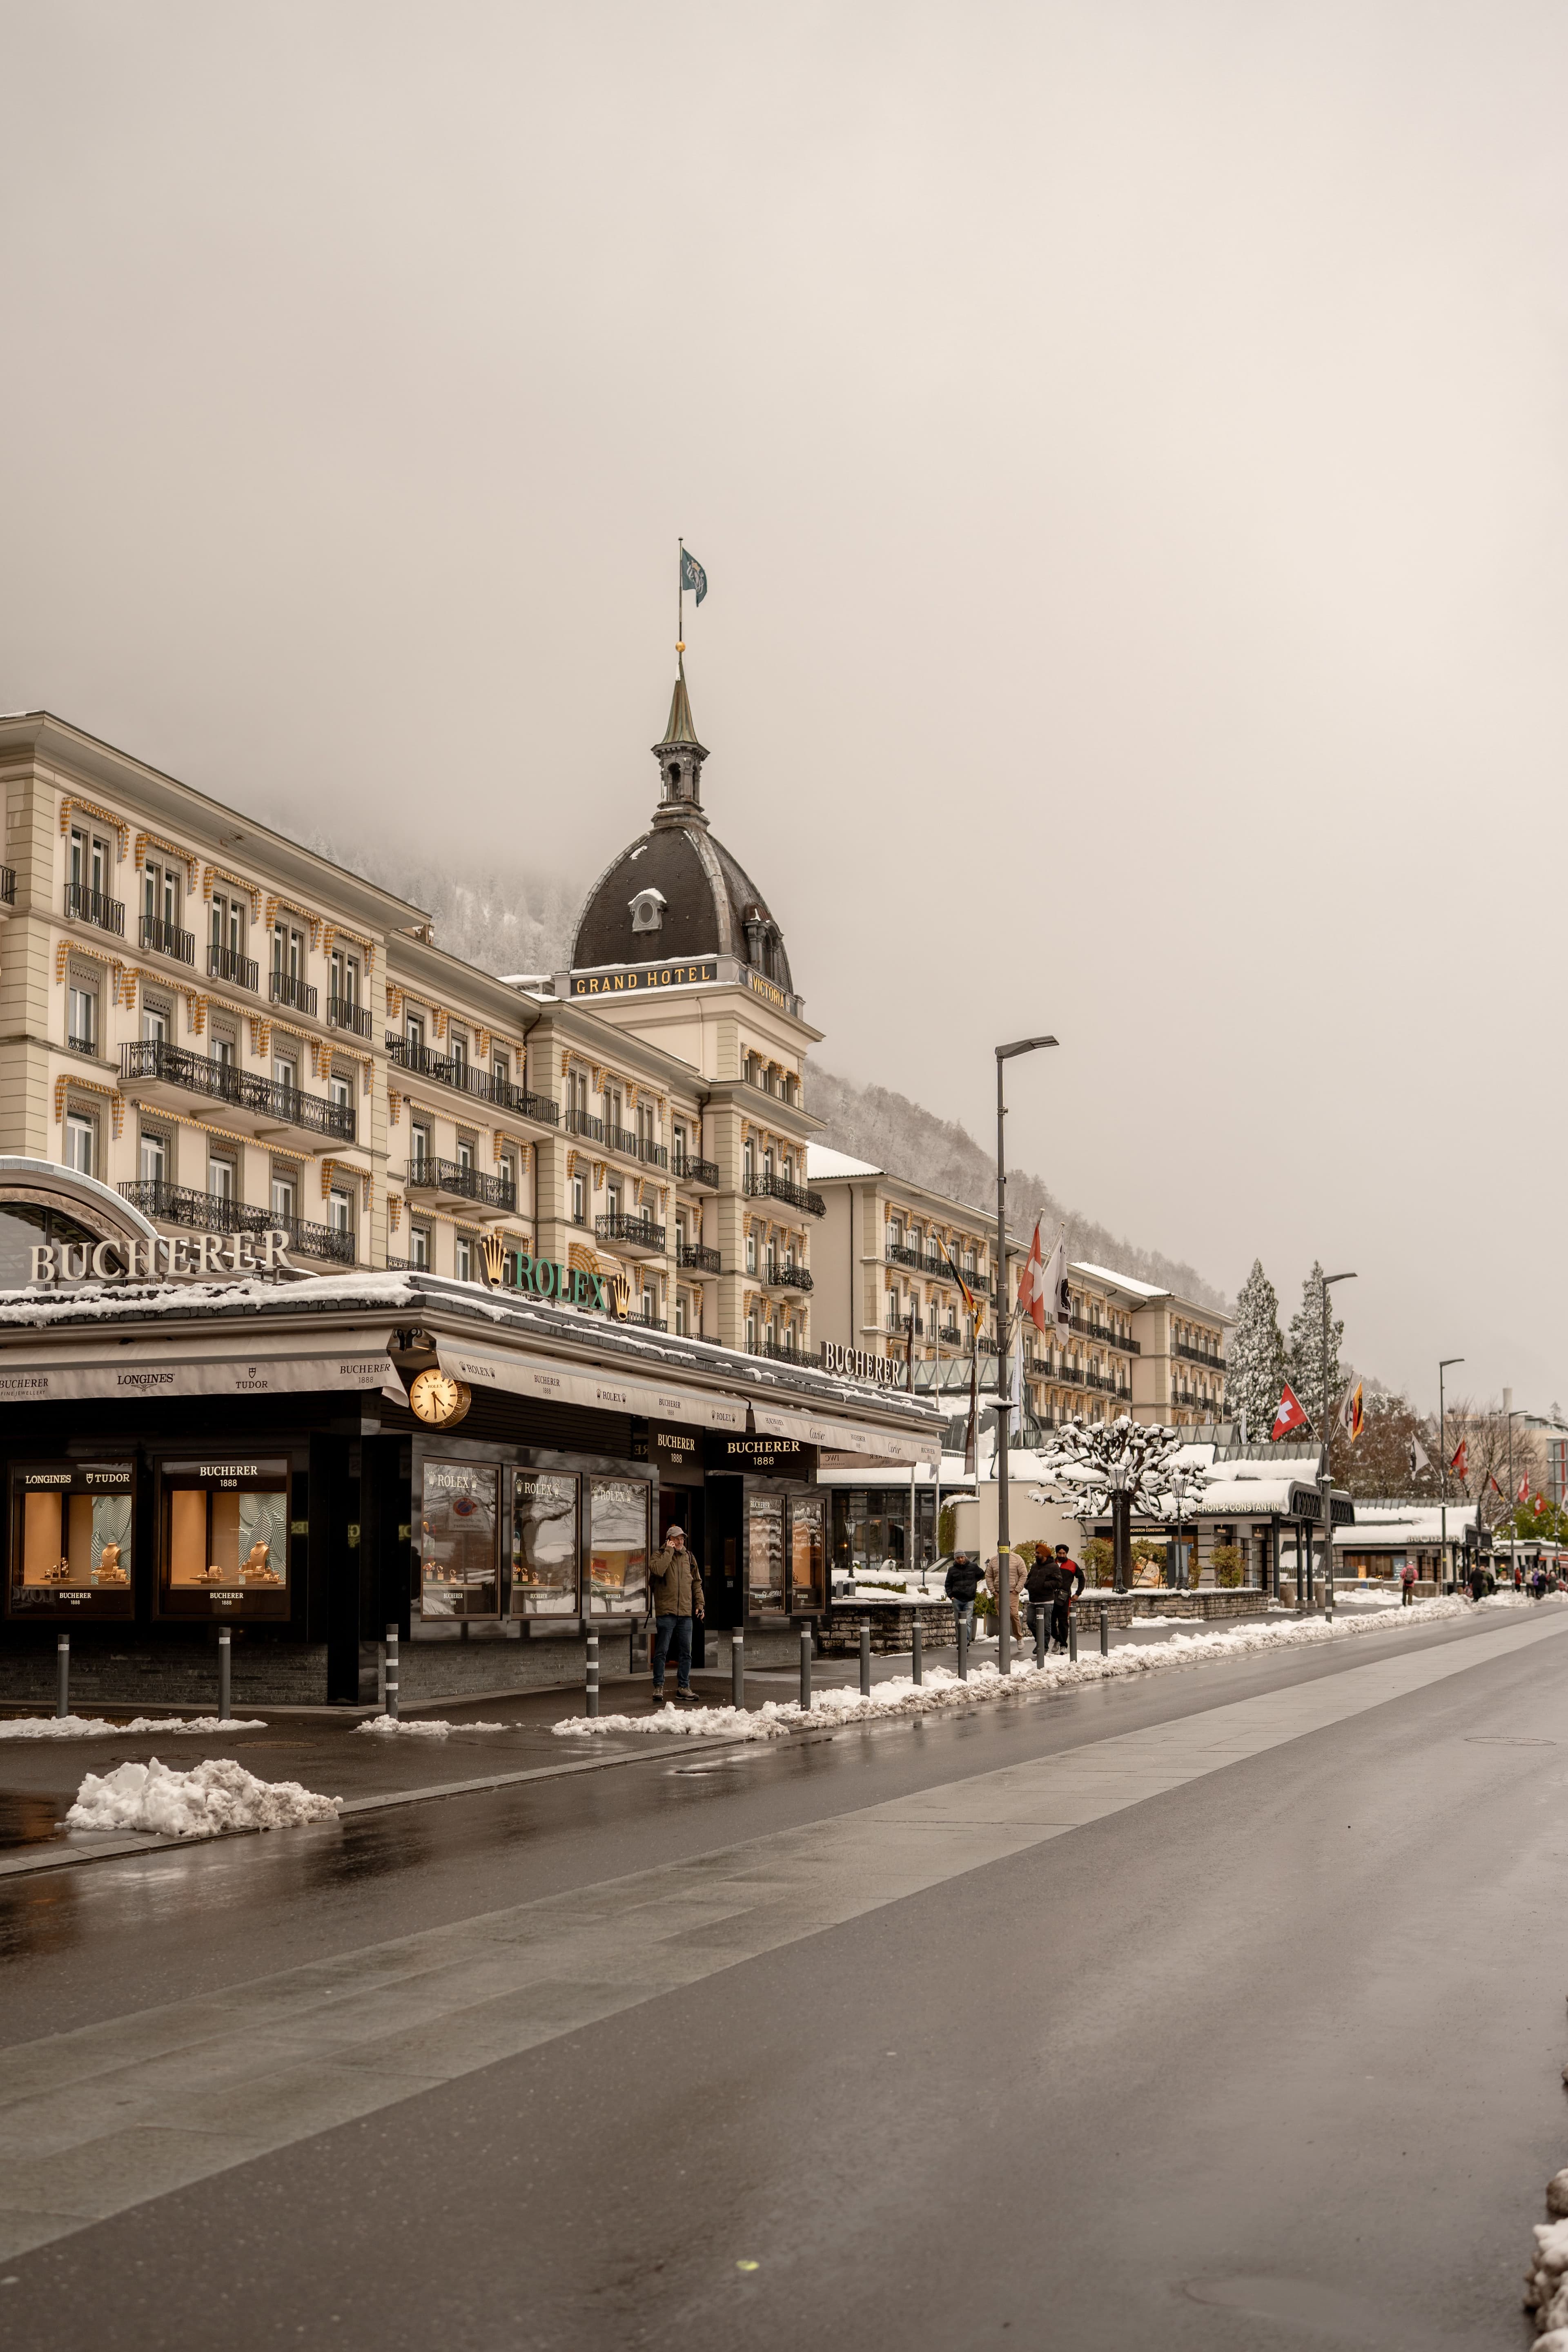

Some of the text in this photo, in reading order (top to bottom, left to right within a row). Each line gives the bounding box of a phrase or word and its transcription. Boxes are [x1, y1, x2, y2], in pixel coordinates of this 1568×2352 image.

[577, 965, 710, 994] GRAND HOTEL
[752, 974, 784, 1009] VICTORIA
[28, 1229, 297, 1283] BUCHERER
[514, 1251, 608, 1312] ROLEX
[340, 1363, 391, 1374] BUCHERER
[466, 1364, 490, 1376] ROLEX
[824, 1341, 900, 1387] BUCHERER
[0, 1379, 48, 1388] BUCHERER
[117, 1373, 174, 1385] LONGINES
[236, 1381, 268, 1389] TUDOR
[534, 1374, 560, 1387] BUCHERER
[603, 1391, 621, 1402] ROLEX
[659, 1398, 681, 1409] BUCHERER
[716, 1412, 731, 1422] ROLEX
[810, 1428, 825, 1440] Cartier
[657, 1434, 695, 1451] BUCHERER
[727, 1441, 801, 1453] BUCHERER
[671, 1453, 682, 1463] 1888
[753, 1457, 774, 1465] 1888
[199, 1466, 258, 1476] BUCHERER
[25, 1473, 130, 1484] LONGINES TUDOR
[437, 1474, 469, 1488] ROLEX
[524, 1482, 552, 1495] ROLEX
[600, 1490, 625, 1502] ROLEX
[750, 1500, 771, 1509] BUCHERER
[1229, 1502, 1280, 1511] CONSTANTIN
